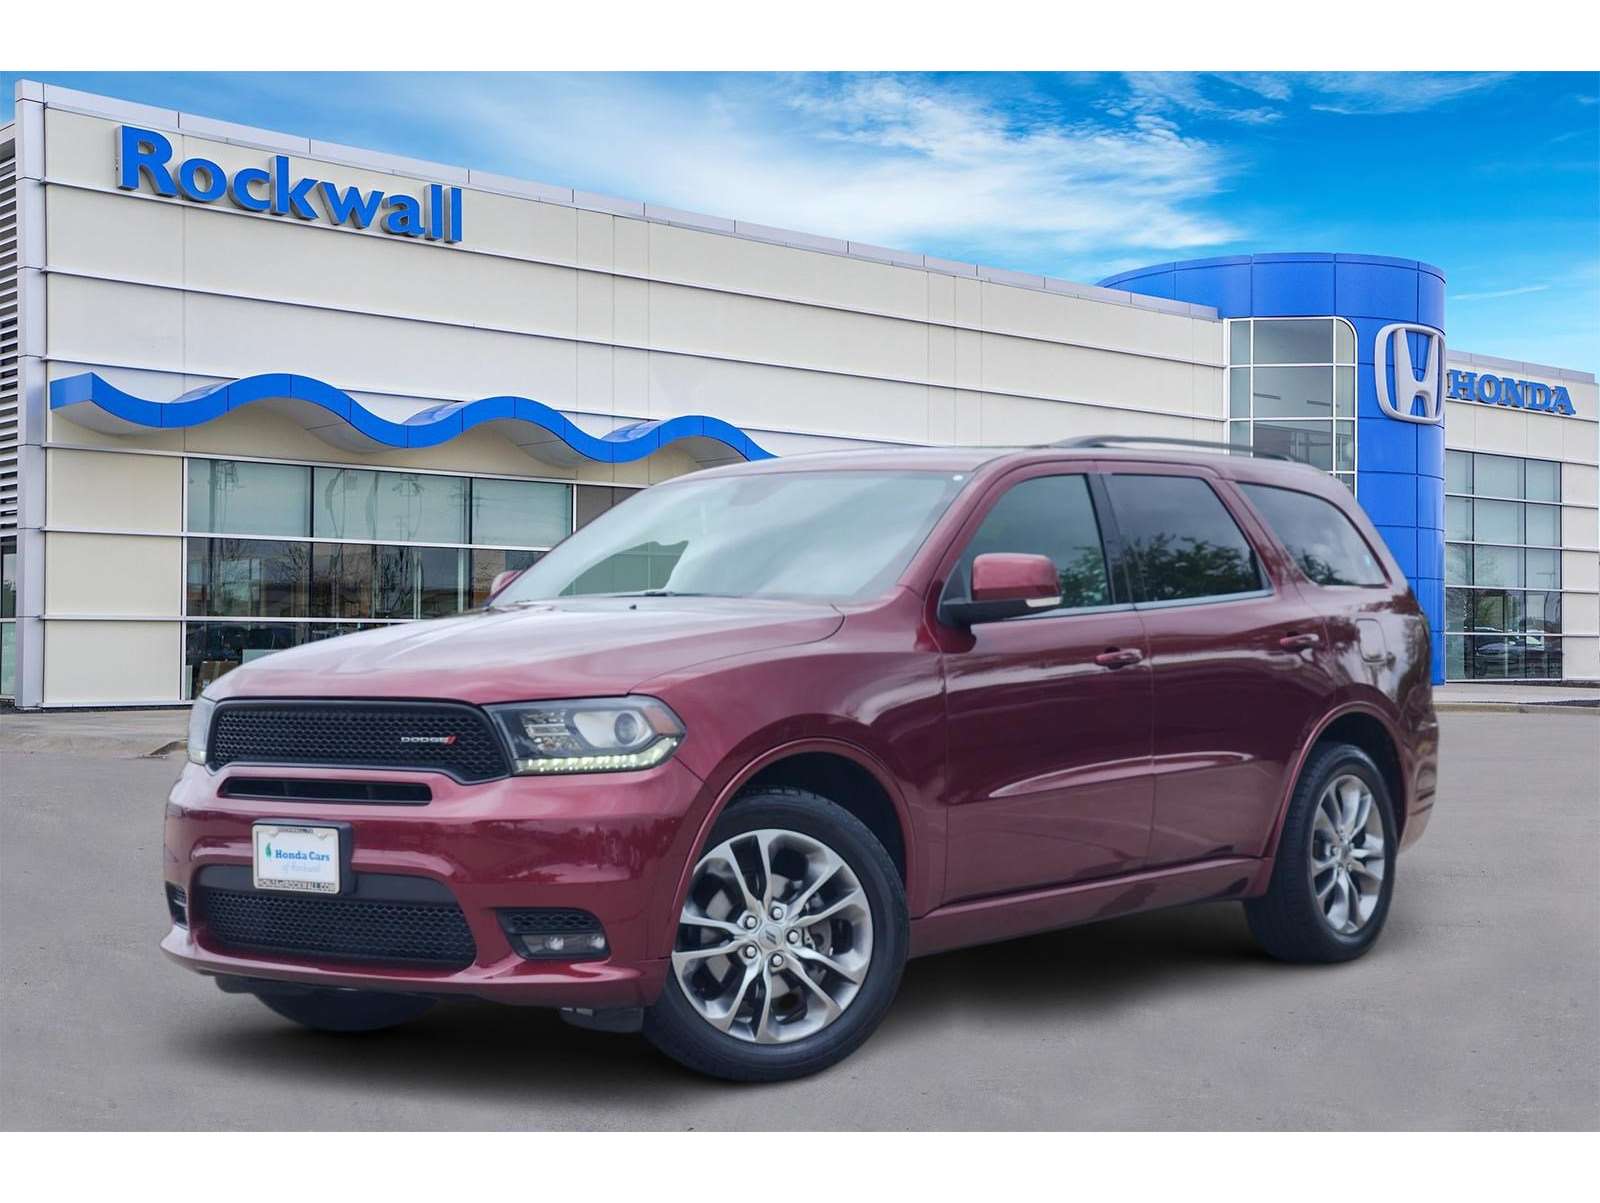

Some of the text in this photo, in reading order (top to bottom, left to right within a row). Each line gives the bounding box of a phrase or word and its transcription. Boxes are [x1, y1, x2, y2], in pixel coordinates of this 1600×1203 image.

[117, 125, 463, 243] Rockwall
[1447, 369, 1577, 415] HONDA
[275, 848, 331, 862] Honda Cars
